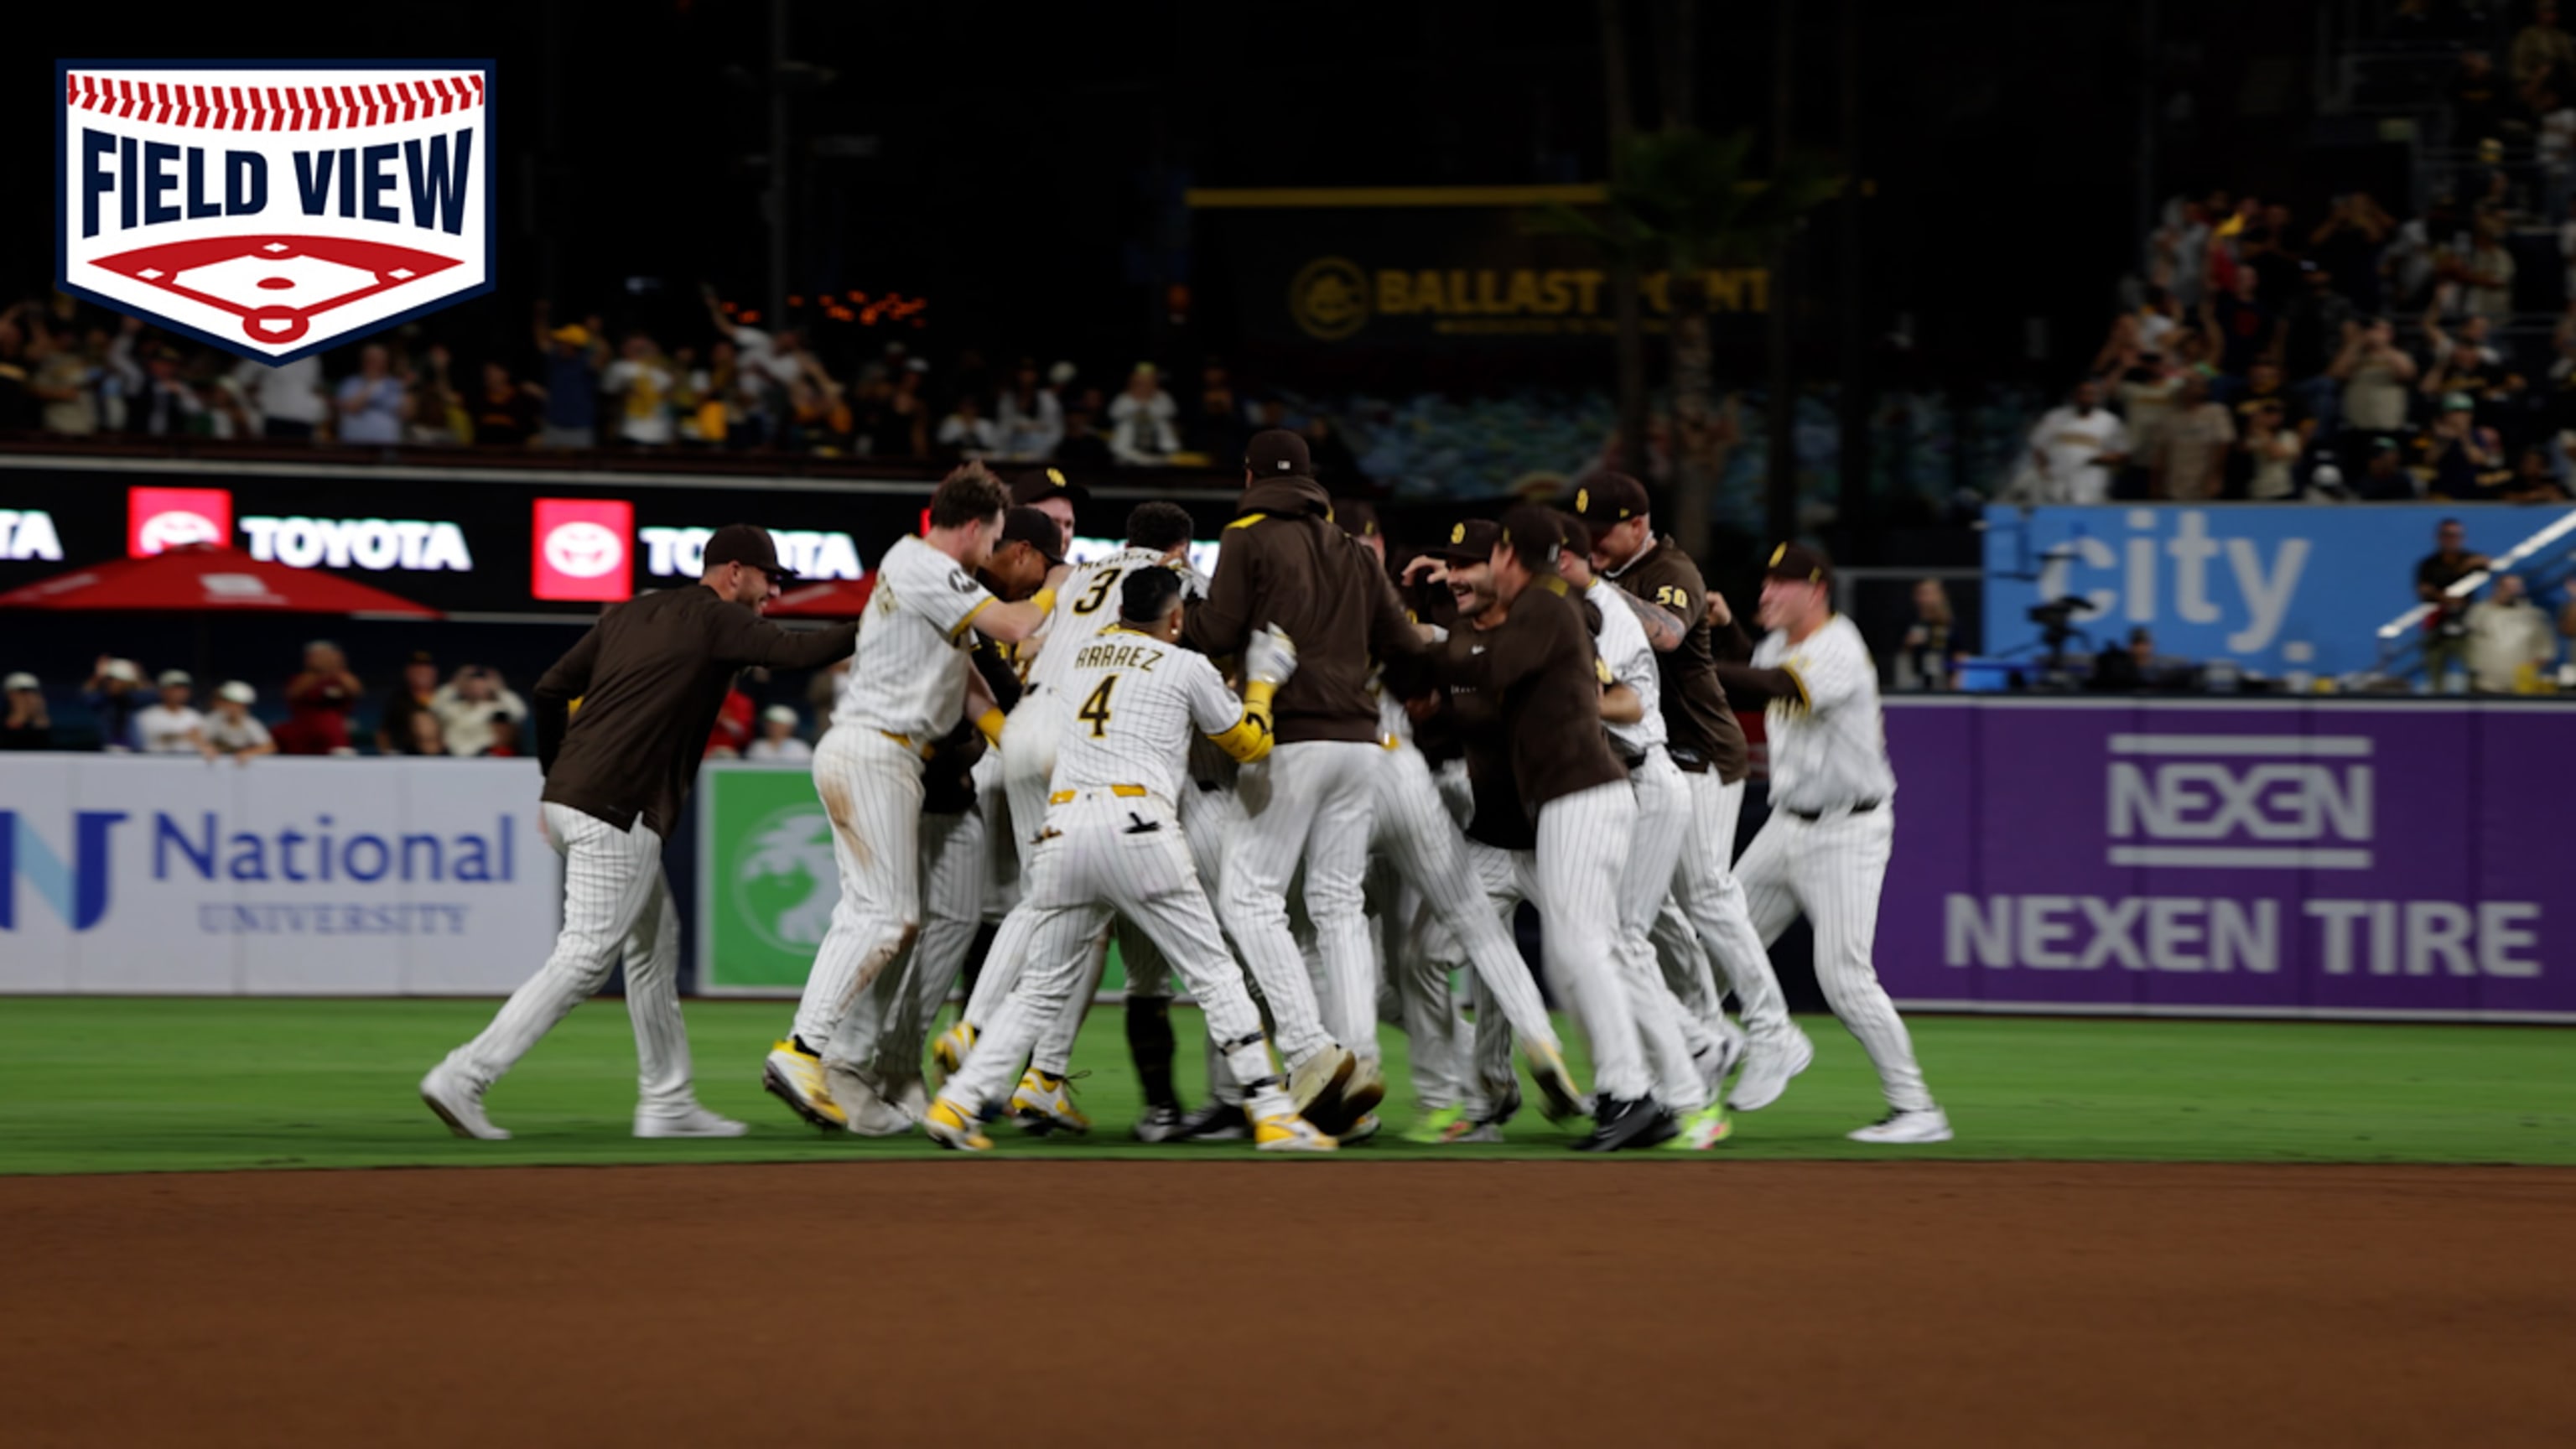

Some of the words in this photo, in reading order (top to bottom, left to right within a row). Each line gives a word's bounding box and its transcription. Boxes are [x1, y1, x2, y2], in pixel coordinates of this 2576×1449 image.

[1376, 269, 1606, 314] BALLAST
[238, 515, 474, 571] TOYOTA
[638, 527, 865, 580] TOTA
[1073, 567, 1123, 616] 3
[1656, 585, 1688, 609] 50
[2039, 507, 2313, 662] city.
[1075, 643, 1164, 673] ARRAEZ
[1077, 673, 1121, 739] 4
[2107, 761, 2375, 841] NEXEN
[153, 810, 516, 883] National
[1943, 893, 2281, 974] NEXEN
[2301, 899, 2544, 978] TIRE
